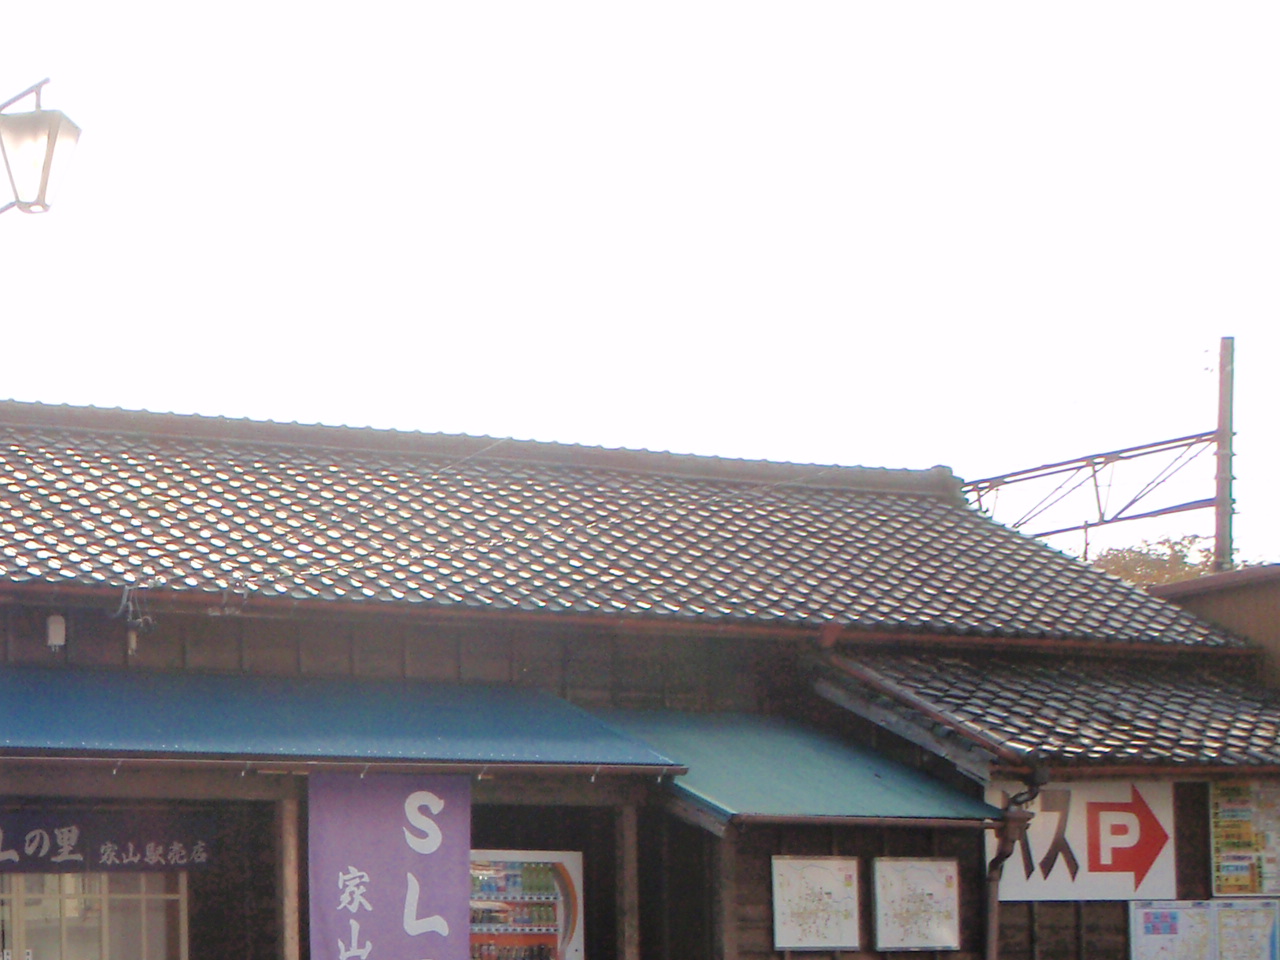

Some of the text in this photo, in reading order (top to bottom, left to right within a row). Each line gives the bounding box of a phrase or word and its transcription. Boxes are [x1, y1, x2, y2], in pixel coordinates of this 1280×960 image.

[99, 840, 208, 865] 家山駅売店
[1099, 811, 1140, 865] P
